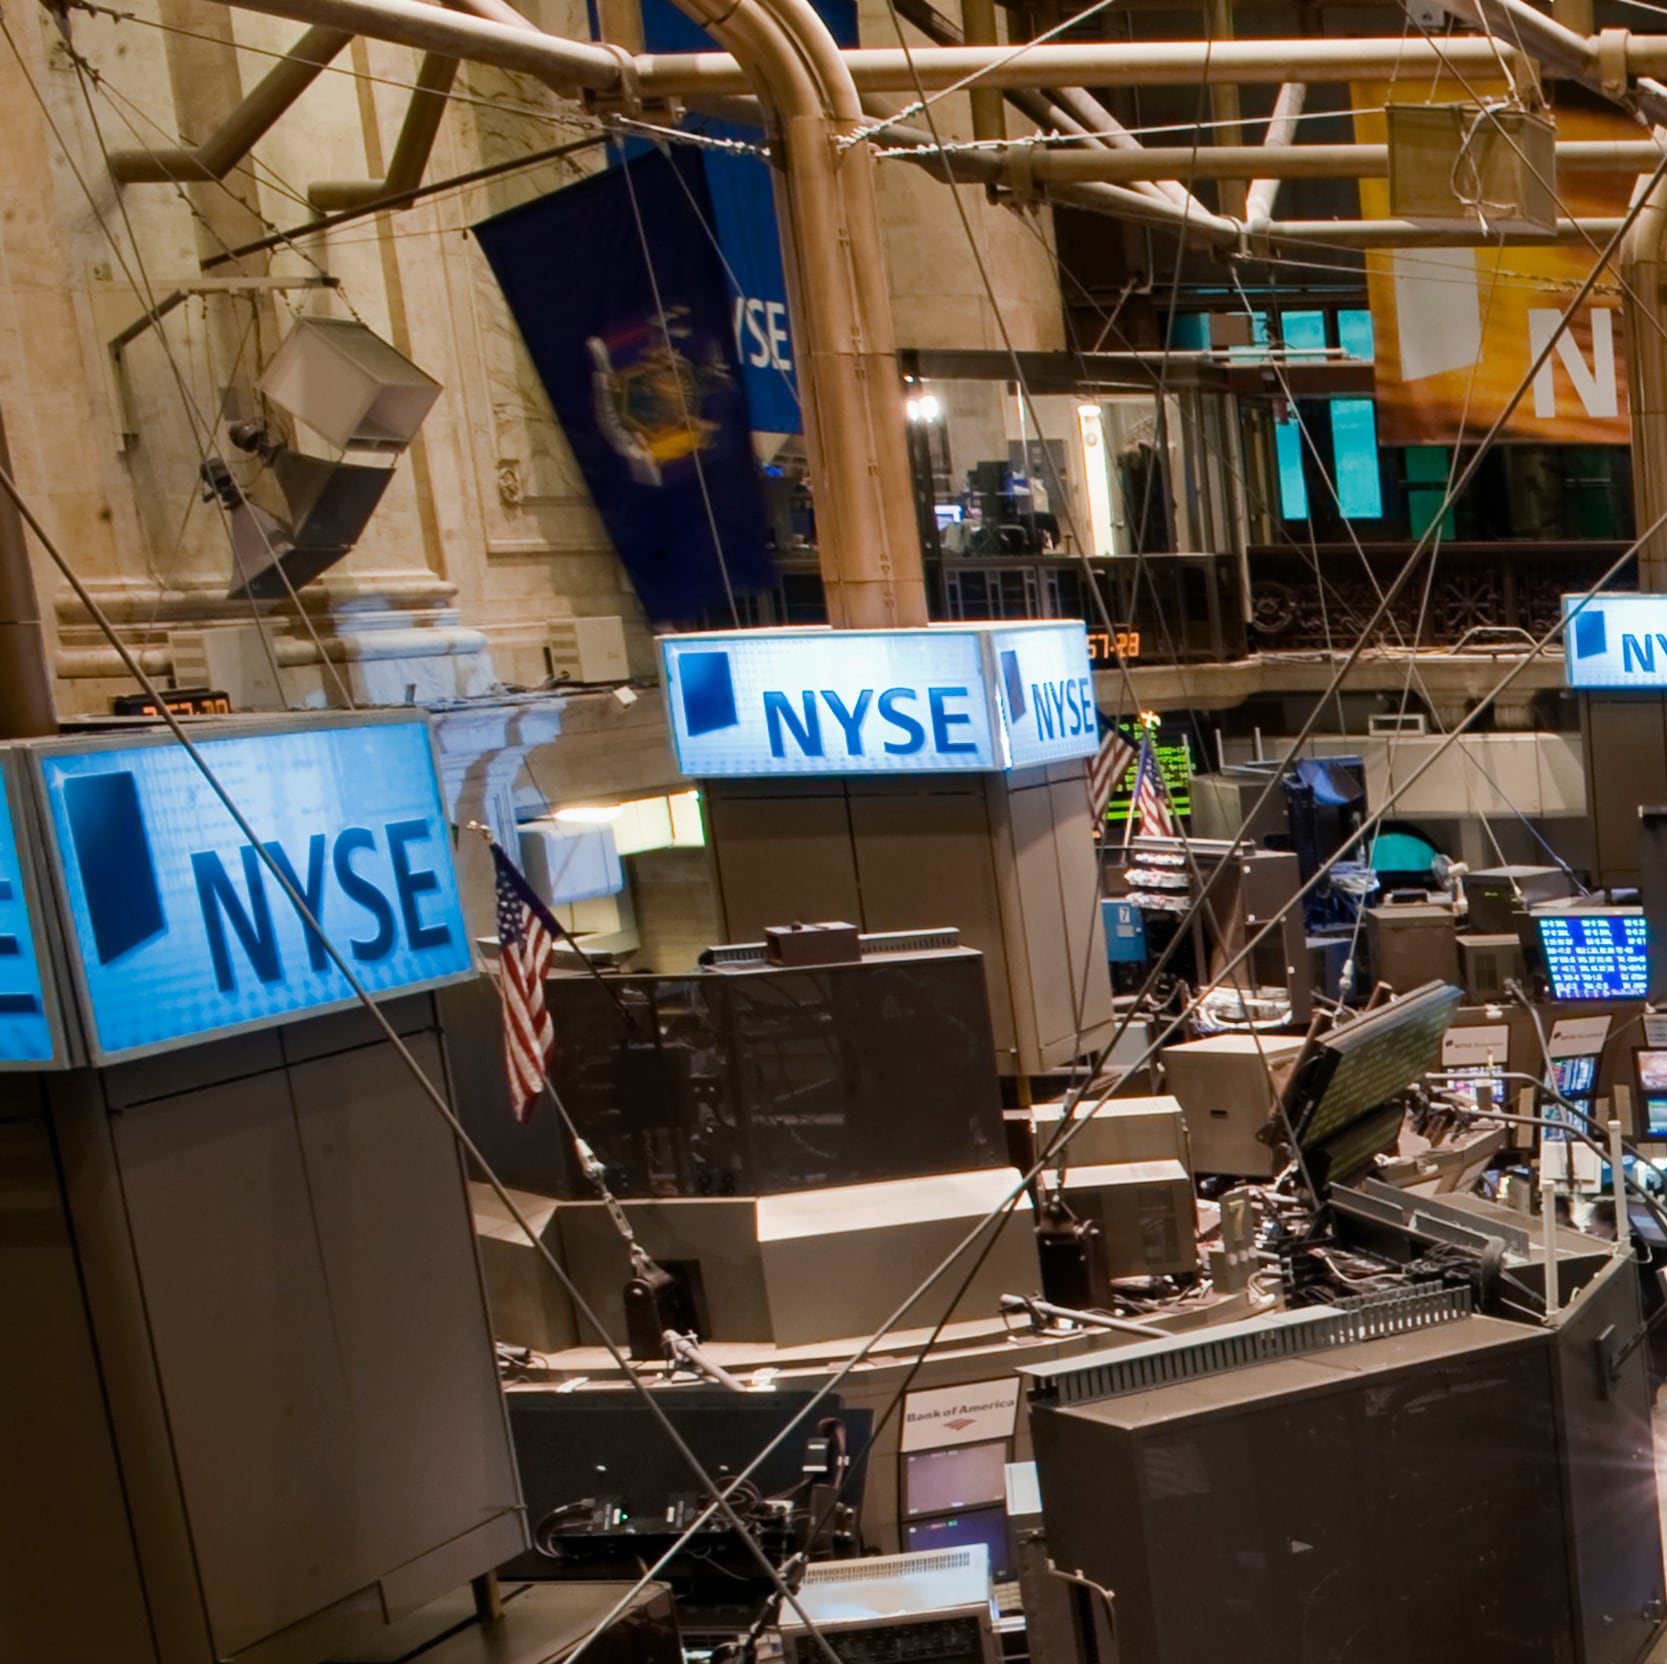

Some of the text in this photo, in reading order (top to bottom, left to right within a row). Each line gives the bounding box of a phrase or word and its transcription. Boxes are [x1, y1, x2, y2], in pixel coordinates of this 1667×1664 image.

[763, 687, 977, 758] NYSE
[1032, 676, 1095, 742] NYSE
[191, 817, 450, 992] NYSE
[1229, 1199, 1246, 1240] 7
[907, 1399, 1015, 1424] Bank of America
